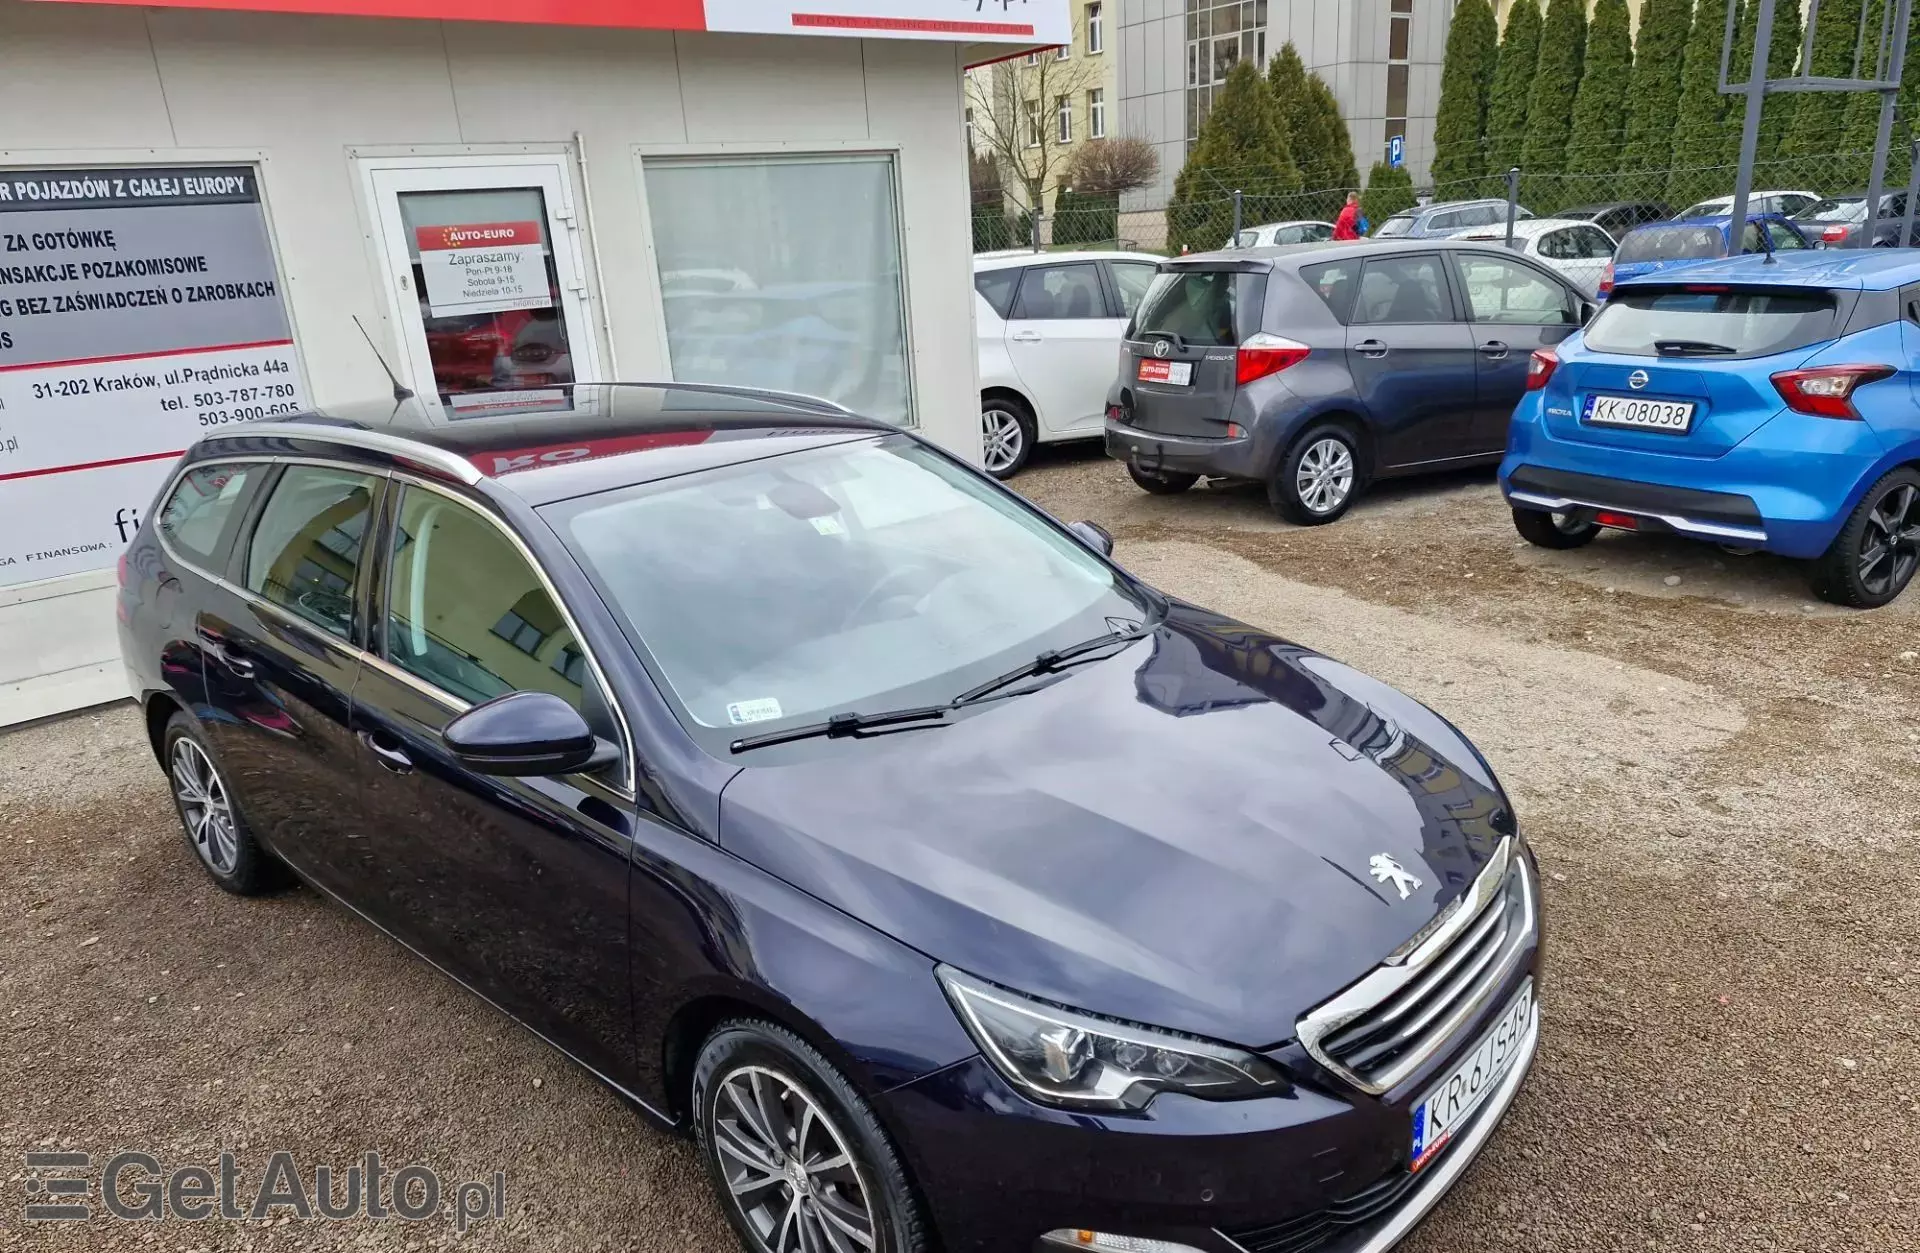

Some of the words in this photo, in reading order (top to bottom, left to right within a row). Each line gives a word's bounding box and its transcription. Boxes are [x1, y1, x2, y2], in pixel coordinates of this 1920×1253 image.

[1393, 139, 1400, 160] P
[14, 176, 110, 200] POJAZDÓW
[113, 179, 127, 197] Z
[129, 177, 180, 197] CAŁEJ
[183, 176, 245, 195] EUROPY
[4, 234, 29, 252] ZA
[32, 227, 117, 251] GOTÓWKĘ
[450, 229, 515, 241] AUTO-EURO
[0, 264, 79, 285] NSAKCJE
[81, 256, 208, 279] POZAKOMISOWE
[495, 265, 513, 274] 9-18
[463, 288, 499, 297] Niedziela
[501, 285, 523, 294] 10-15
[467, 278, 495, 287] Sobota
[16, 298, 51, 316] BEZ
[53, 285, 168, 312] ZAŚWIADCZEŃ
[171, 288, 182, 303] O
[185, 281, 276, 302] ZAROBKACH
[32, 378, 90, 399] 31-202
[93, 373, 161, 393] Kraków,
[164, 362, 259, 385] ul.Prądnicka
[263, 359, 289, 374] 44a
[160, 396, 189, 411] tel.
[194, 383, 295, 407] 503-787-780
[1595, 399, 1621, 420] KK
[1626, 402, 1685, 426] 08038
[25, 542, 113, 562] FINANSOWA:
[1430, 1074, 1462, 1138] KR
[1470, 995, 1528, 1094] 6JS49
